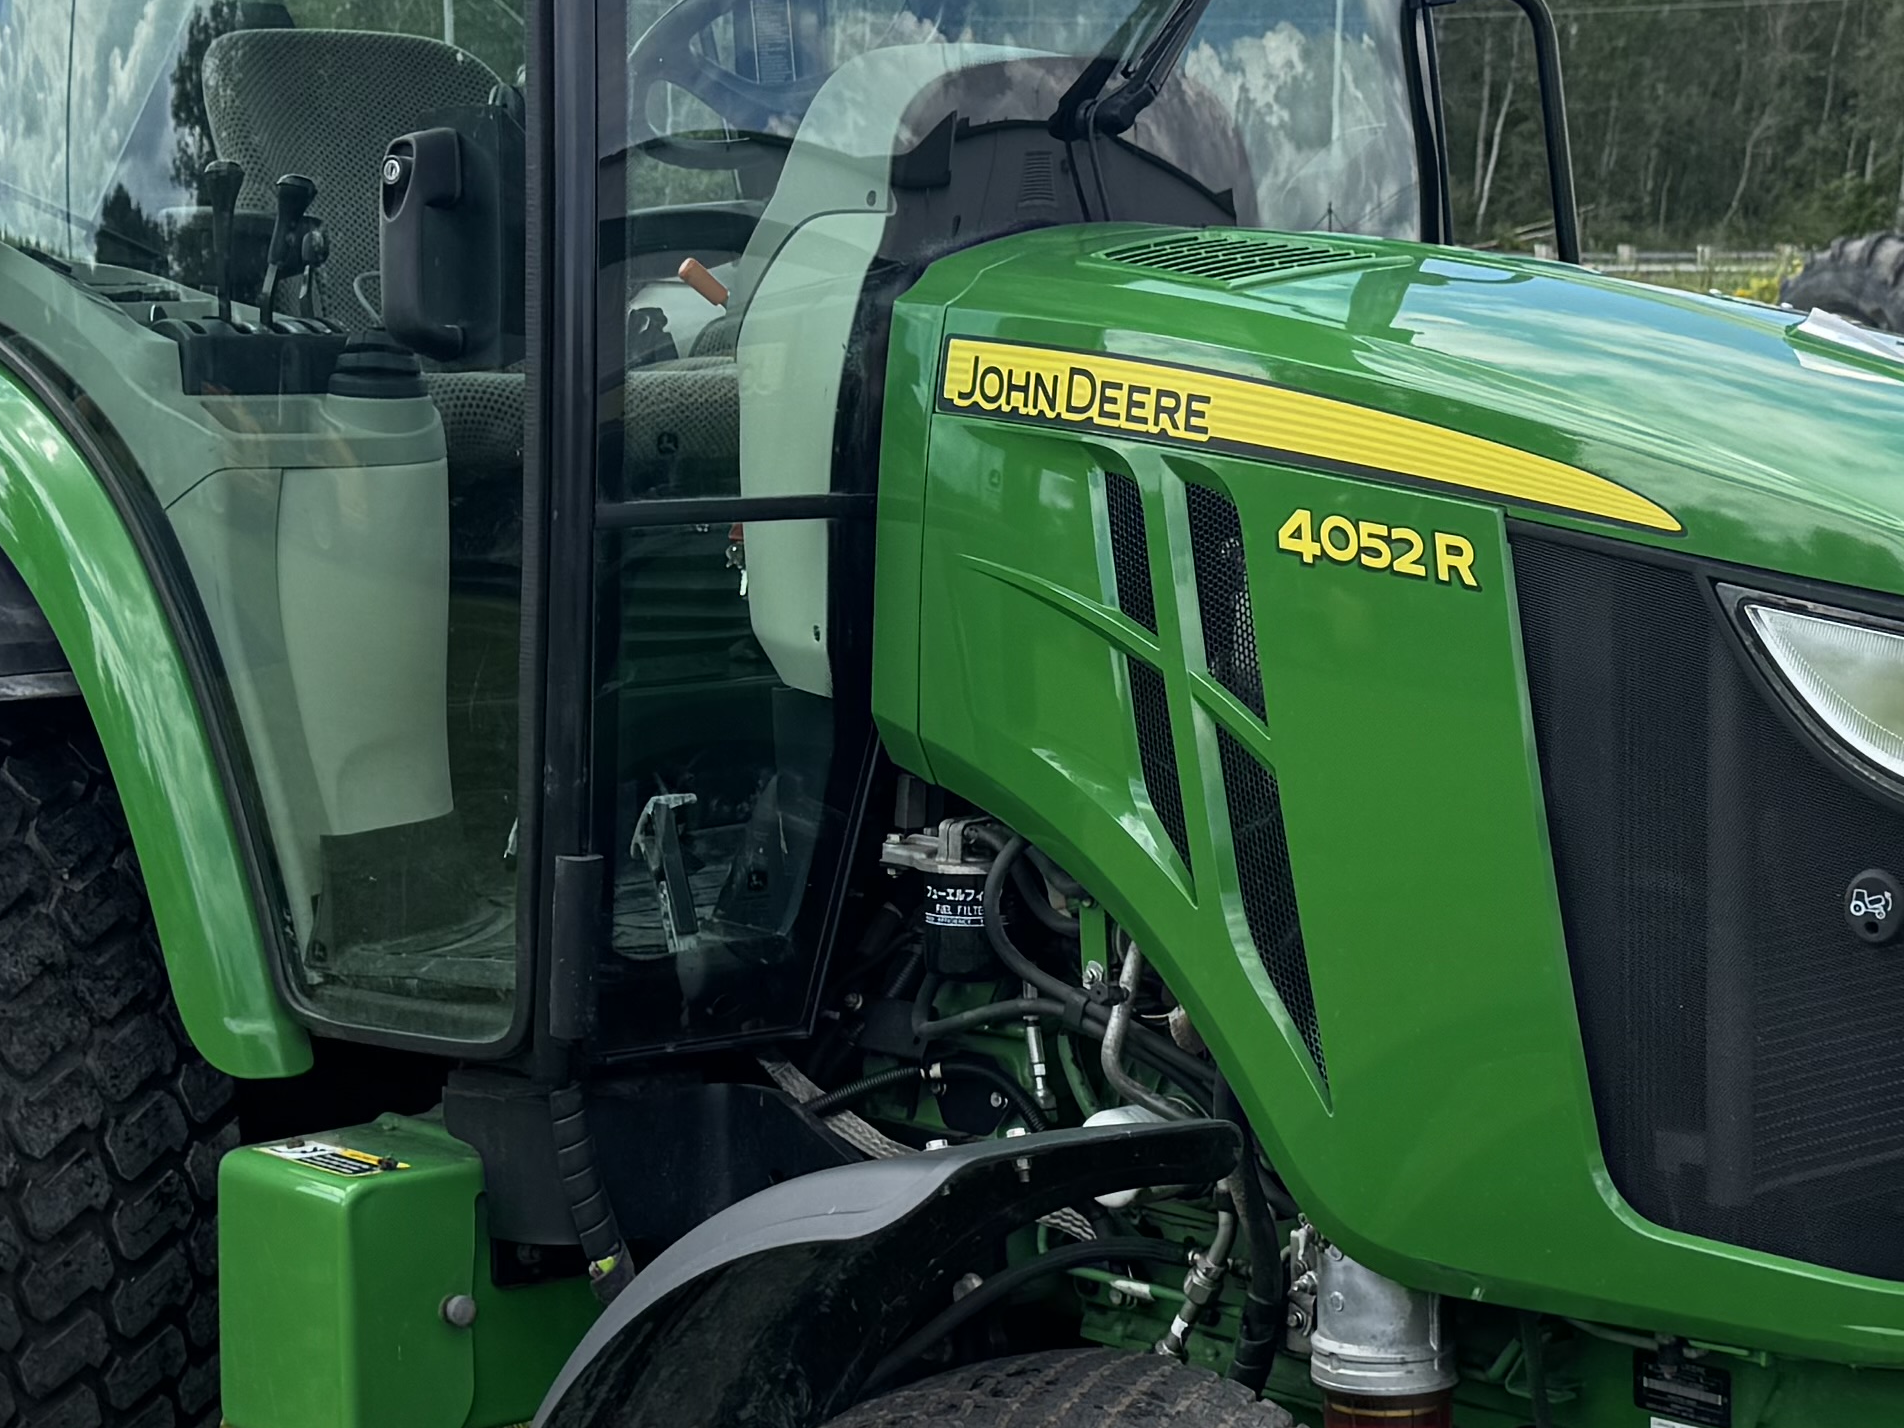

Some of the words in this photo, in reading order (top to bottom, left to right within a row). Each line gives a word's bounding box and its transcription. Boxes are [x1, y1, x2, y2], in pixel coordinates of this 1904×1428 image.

[957, 355, 1059, 413] JOHN
[1065, 366, 1212, 436] DEERE
[926, 885, 984, 901] フューエルフィ
[957, 905, 984, 916] FILTE
